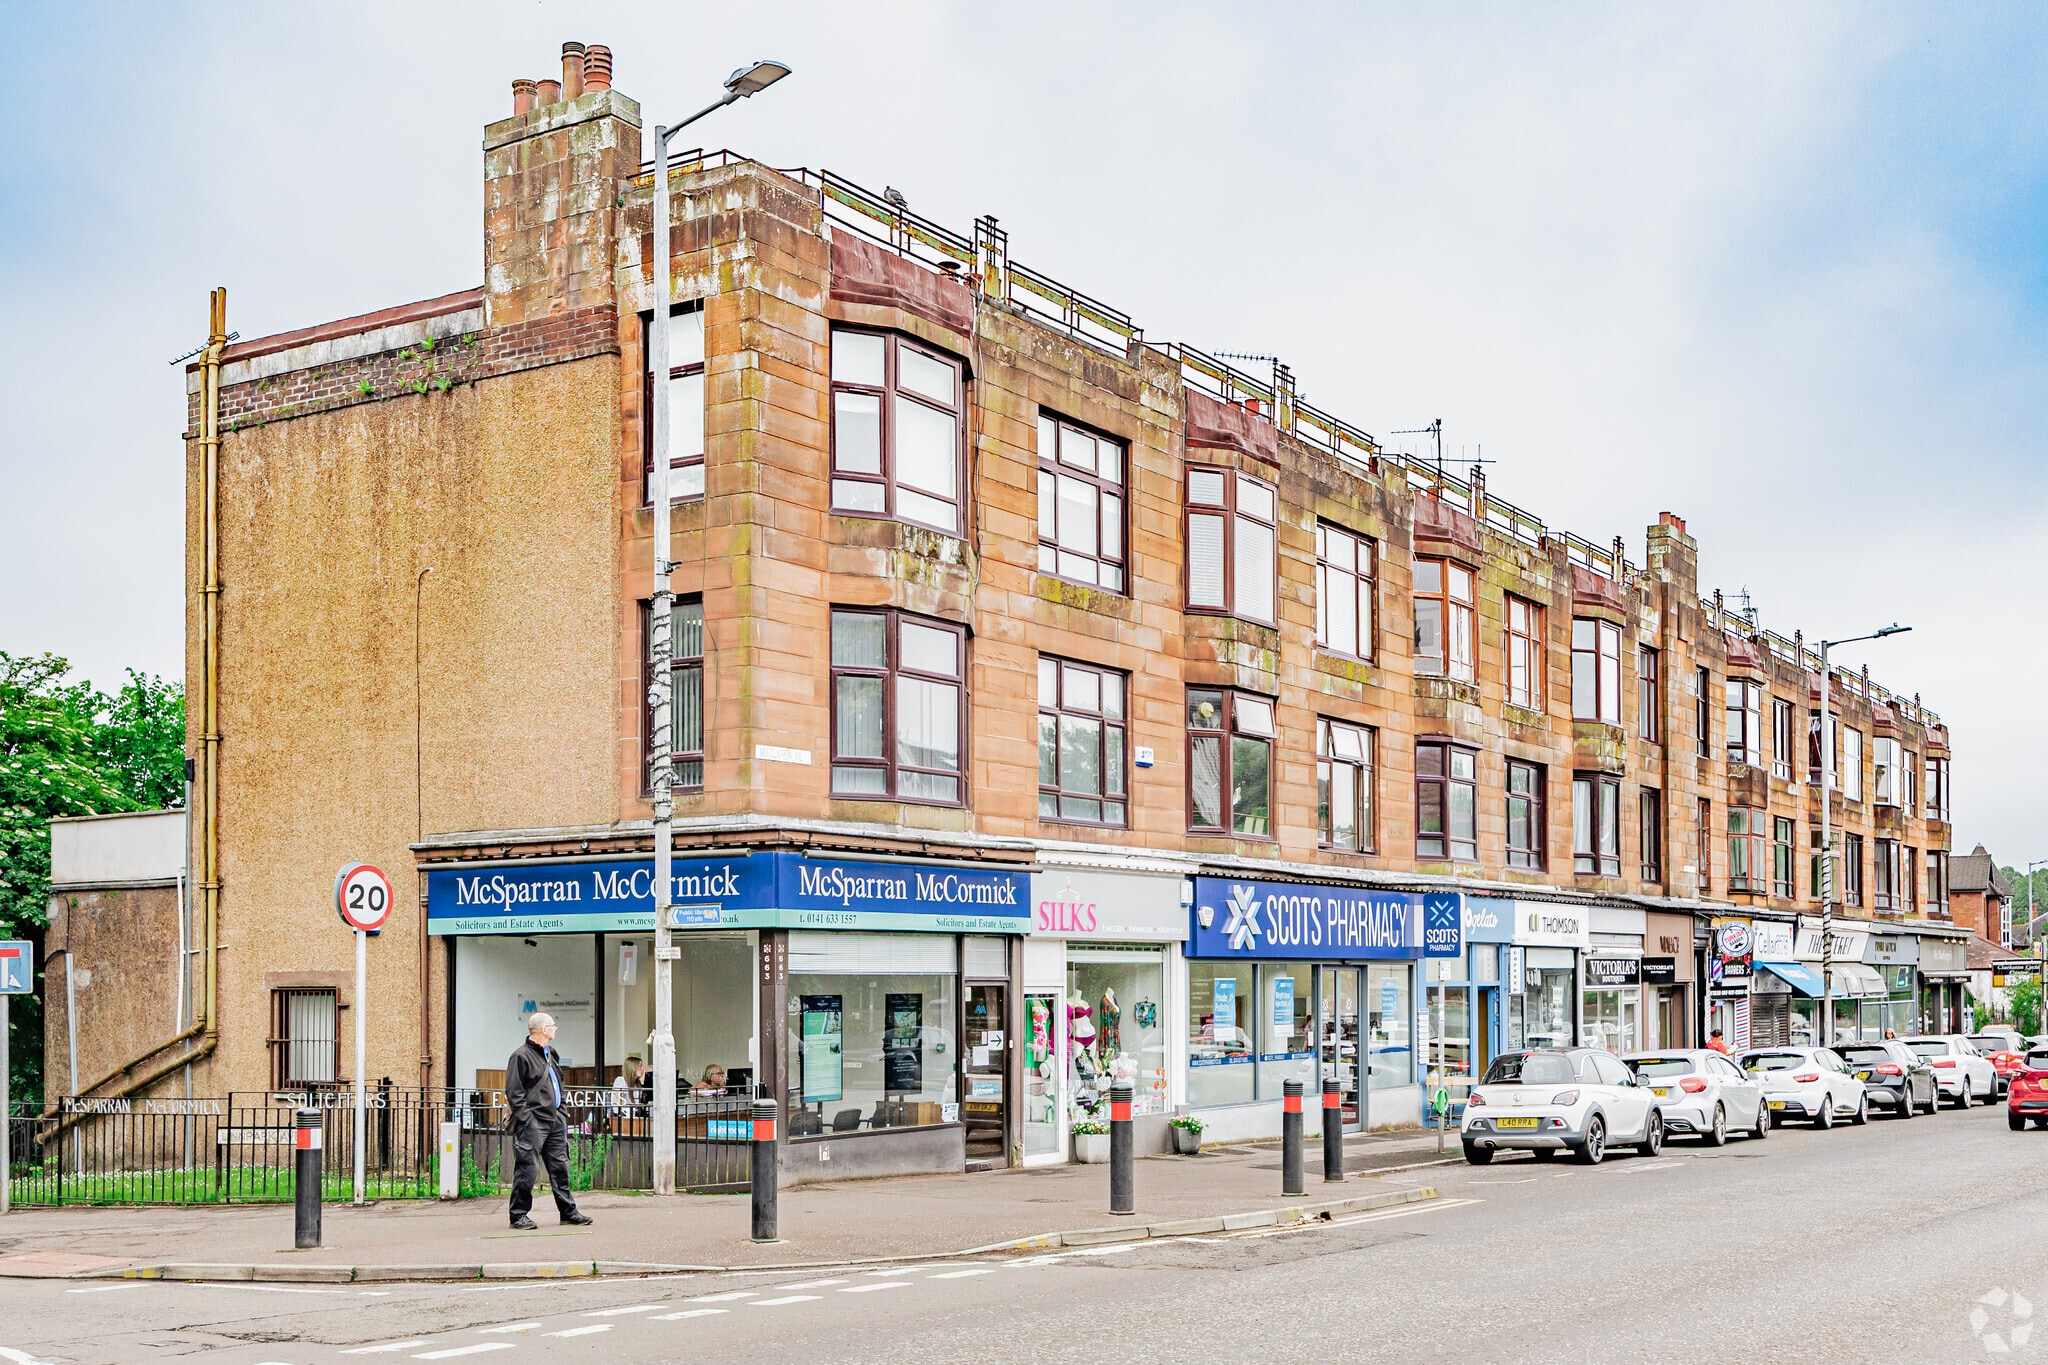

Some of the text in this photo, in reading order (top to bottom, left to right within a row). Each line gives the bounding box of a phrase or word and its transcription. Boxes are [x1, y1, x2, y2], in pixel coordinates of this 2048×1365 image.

[456, 865, 740, 911] McSparran McCrmick
[799, 865, 1017, 905] McSparran McCormick
[349, 884, 385, 911] 20
[455, 918, 564, 930] Solicitors and Estate Agents
[799, 913, 857, 924] t. 0141 633 1557
[936, 917, 1017, 929] Solicitors and Estate Agents
[1038, 901, 1097, 932] SILKS
[1266, 894, 1407, 948] SCOTS PHARMACY
[1542, 917, 1579, 934] THOMSON
[1426, 929, 1458, 943] SCOTS
[1429, 944, 1455, 952] PHARMACY
[1590, 960, 1636, 975] VICTORIA'S
[65, 1092, 386, 1114] McSPARRAN McCORMICK SOLICITRS
[565, 1091, 627, 1107] AGENTS
